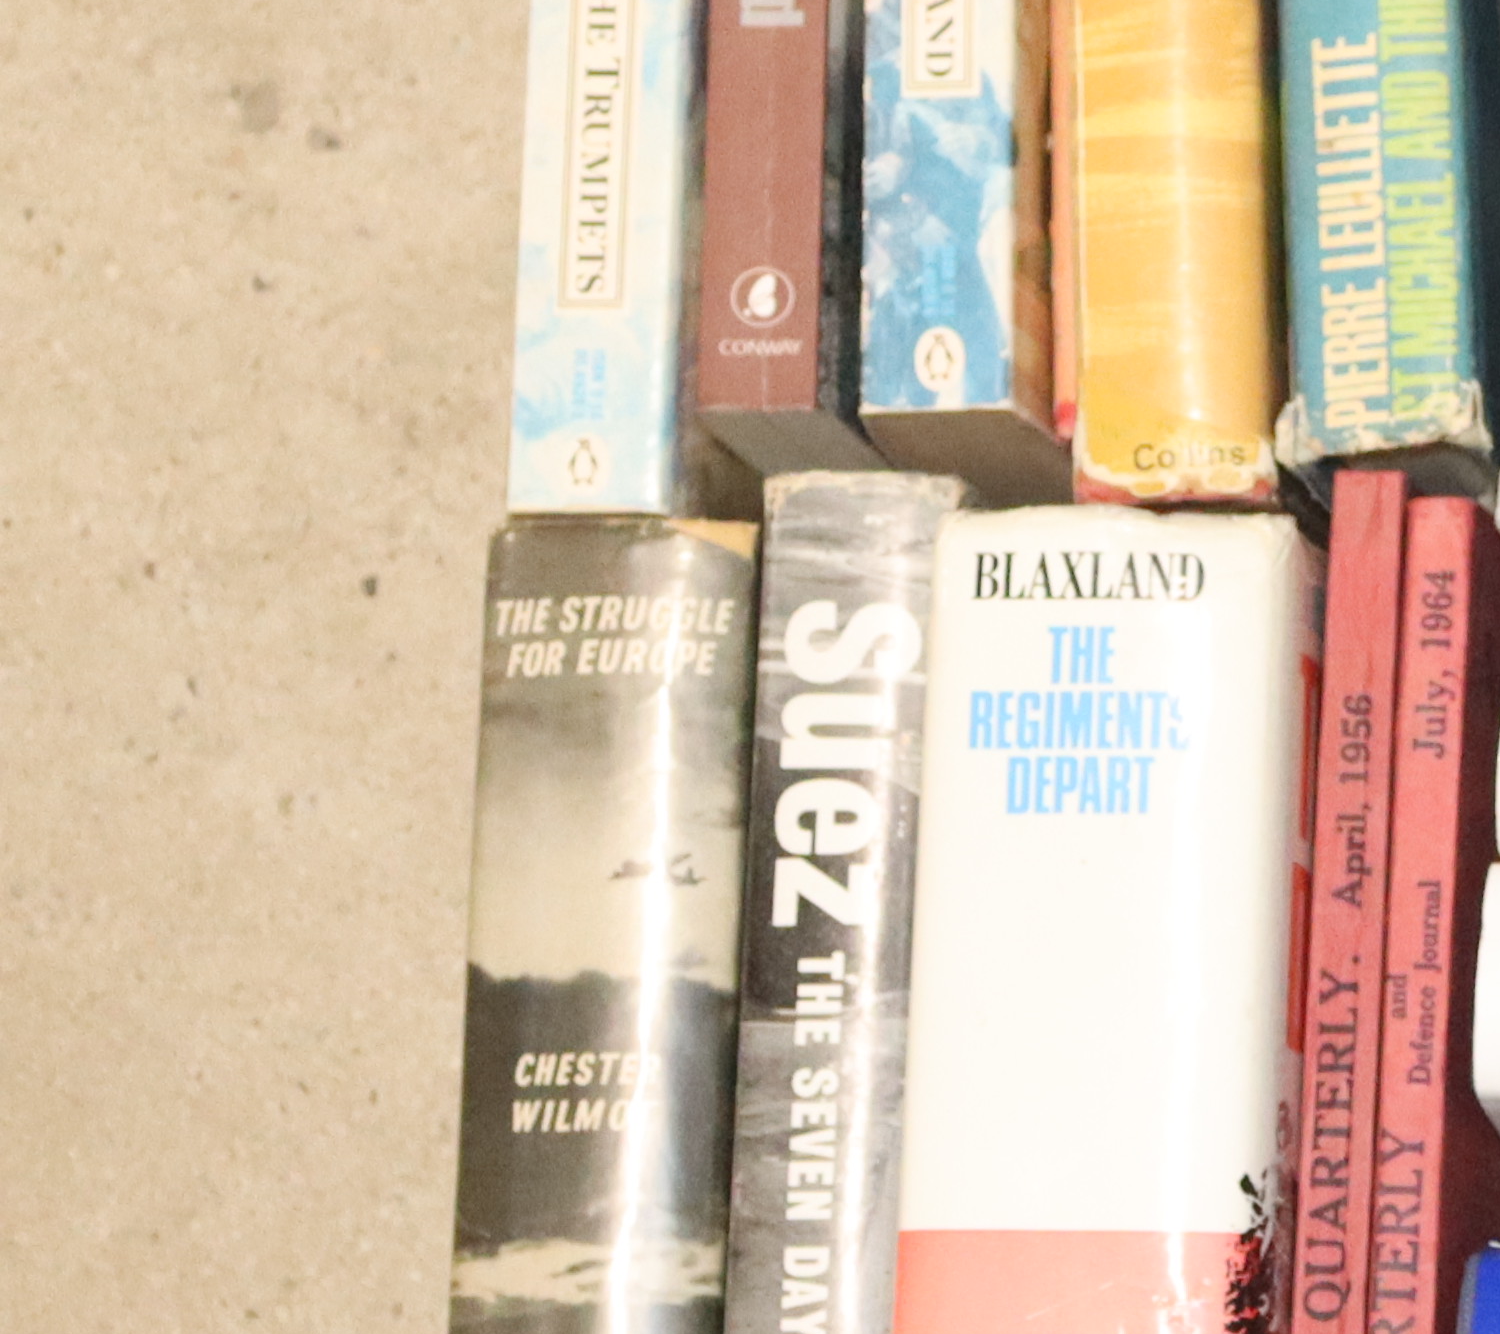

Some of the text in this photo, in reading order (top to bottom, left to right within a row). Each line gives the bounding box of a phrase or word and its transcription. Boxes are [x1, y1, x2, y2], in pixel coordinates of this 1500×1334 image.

[1315, 36, 1390, 429] PIERRE LEULLIETTE
[975, 553, 1204, 599] BLAXLAND
[1050, 627, 1113, 683] THE
[772, 600, 922, 929] Suez
[1008, 757, 1150, 813] DEPART
[1340, 694, 1372, 782] 1956
[1332, 803, 1372, 909] April,
[793, 952, 848, 1046] THE
[785, 1065, 841, 1219] SEVEN
[1300, 954, 1362, 1323] QUARTERLY.
